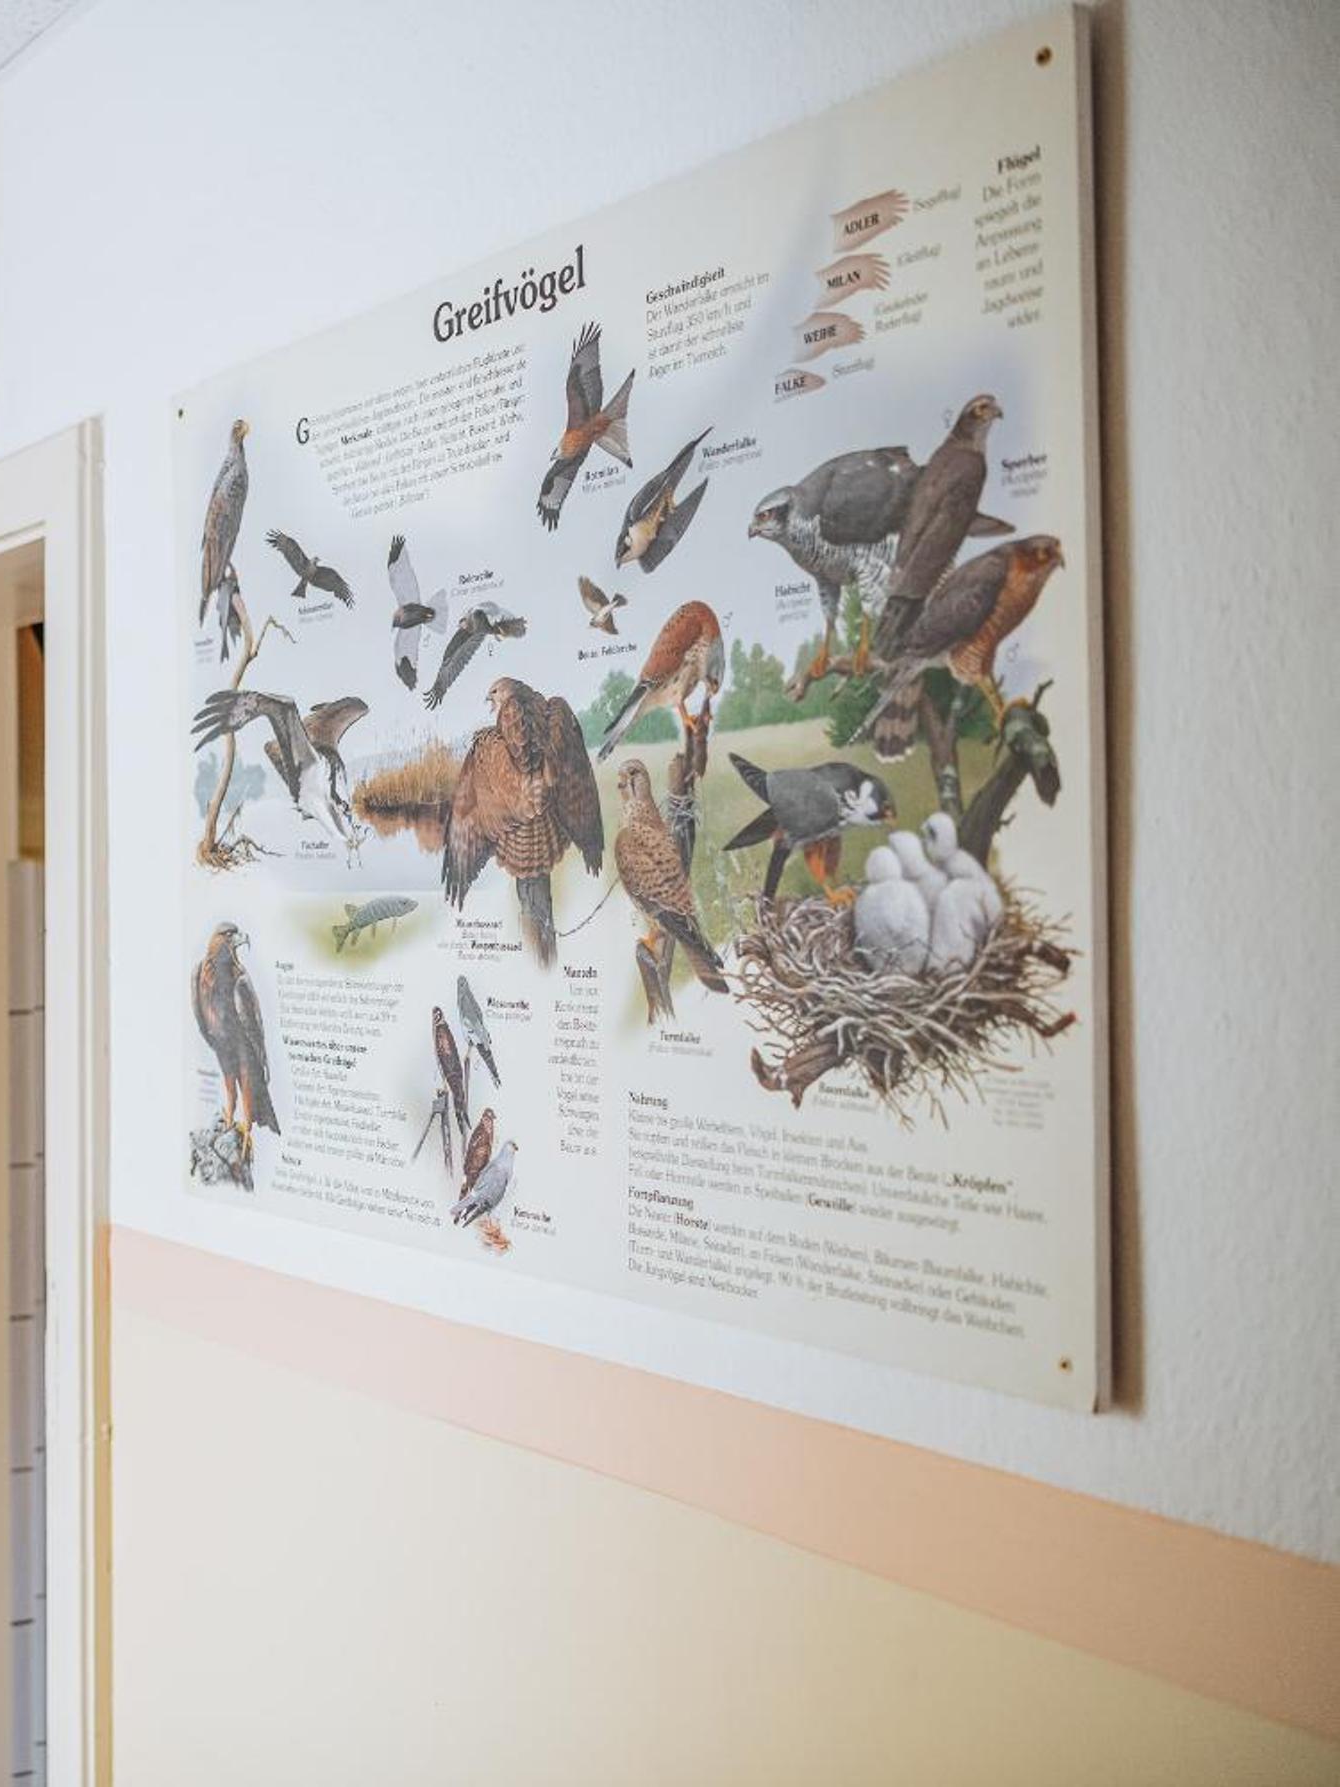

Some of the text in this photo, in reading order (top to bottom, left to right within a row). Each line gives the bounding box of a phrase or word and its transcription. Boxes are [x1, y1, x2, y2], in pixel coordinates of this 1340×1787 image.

[843, 213, 880, 235] ADLER
[646, 268, 724, 304] Geschwindigkeit
[826, 269, 860, 289] MILAN
[433, 244, 586, 342] Greifvögel
[803, 325, 837, 344] WEIHE
[774, 376, 807, 395] FALKE
[703, 437, 757, 458] Wanderfalke
[1001, 453, 1048, 471] Sperber
[775, 582, 810, 597] Habicht
[660, 1030, 701, 1044] Turmfalke
[628, 1091, 667, 1110] Nahrung
[628, 1185, 693, 1211] Fortpflanzung
